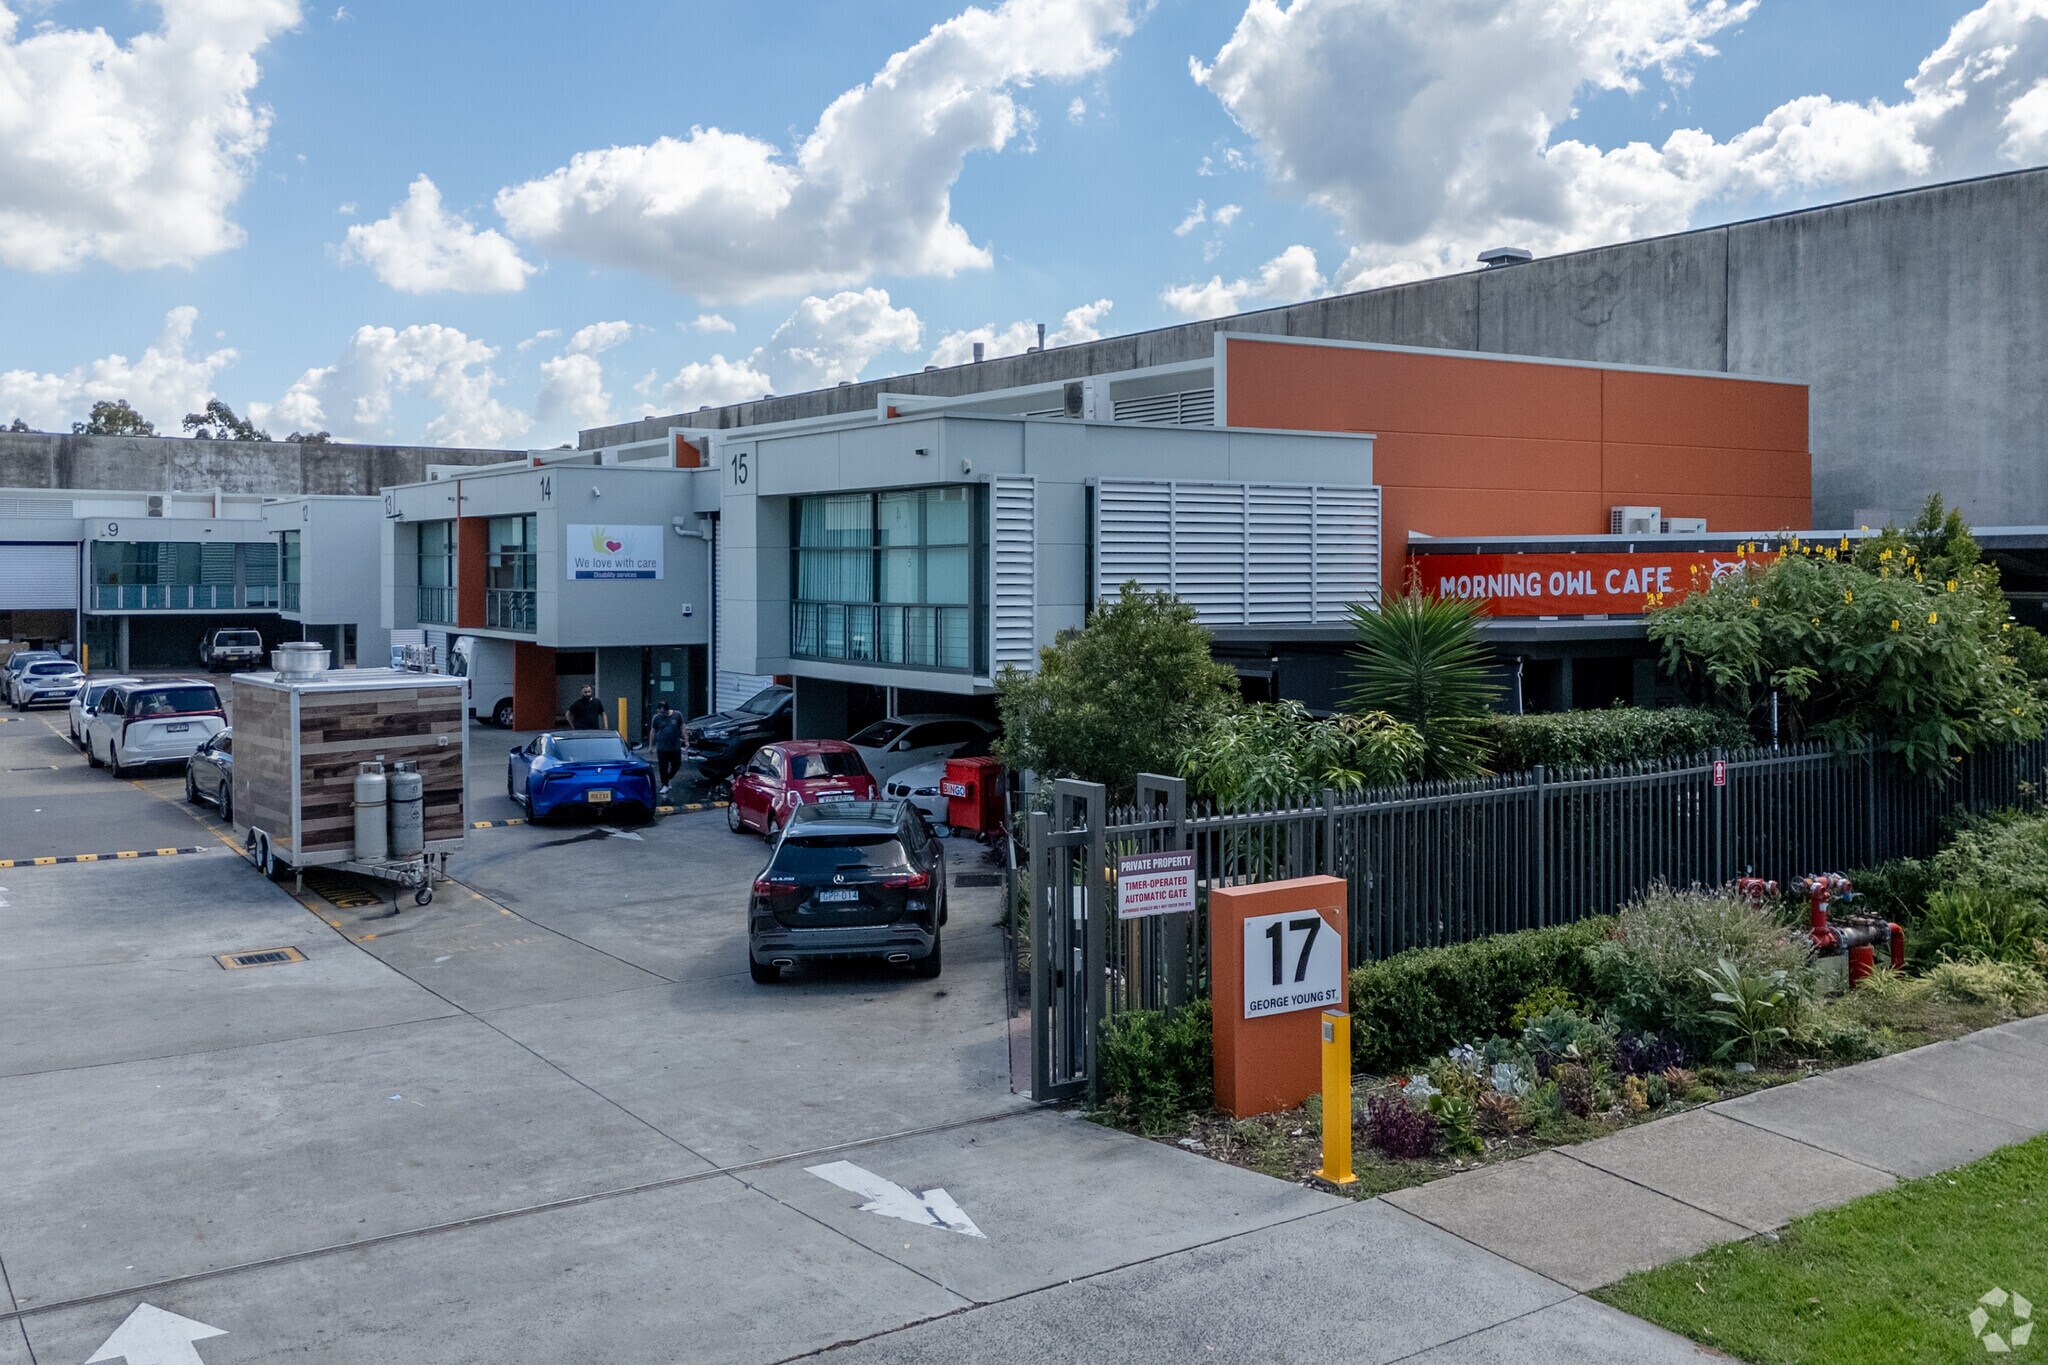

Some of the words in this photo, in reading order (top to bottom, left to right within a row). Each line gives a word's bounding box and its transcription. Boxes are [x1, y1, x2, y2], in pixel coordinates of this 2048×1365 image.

[731, 453, 748, 485] 15
[540, 476, 551, 501] 14
[385, 495, 392, 515] 13
[108, 522, 119, 537] 9
[575, 557, 590, 568] We
[593, 557, 612, 568] love
[615, 557, 634, 568] with
[637, 559, 657, 568] care
[593, 571, 616, 579] Disability
[1440, 572, 1541, 599] MORNING
[1549, 570, 1598, 596] OWL
[1605, 566, 1673, 595] CAFE
[1121, 859, 1151, 872] PRIVATE
[1152, 855, 1192, 869] PROPERTY
[1125, 876, 1188, 891] TIMER-OPERATED
[1125, 890, 1167, 904] AUTOMATIC
[1168, 888, 1188, 899] GATE
[1266, 917, 1321, 986] 17
[1250, 996, 1289, 1011] GEORGE
[1291, 991, 1324, 1005] YOUNG
[1325, 989, 1336, 1000] ST
